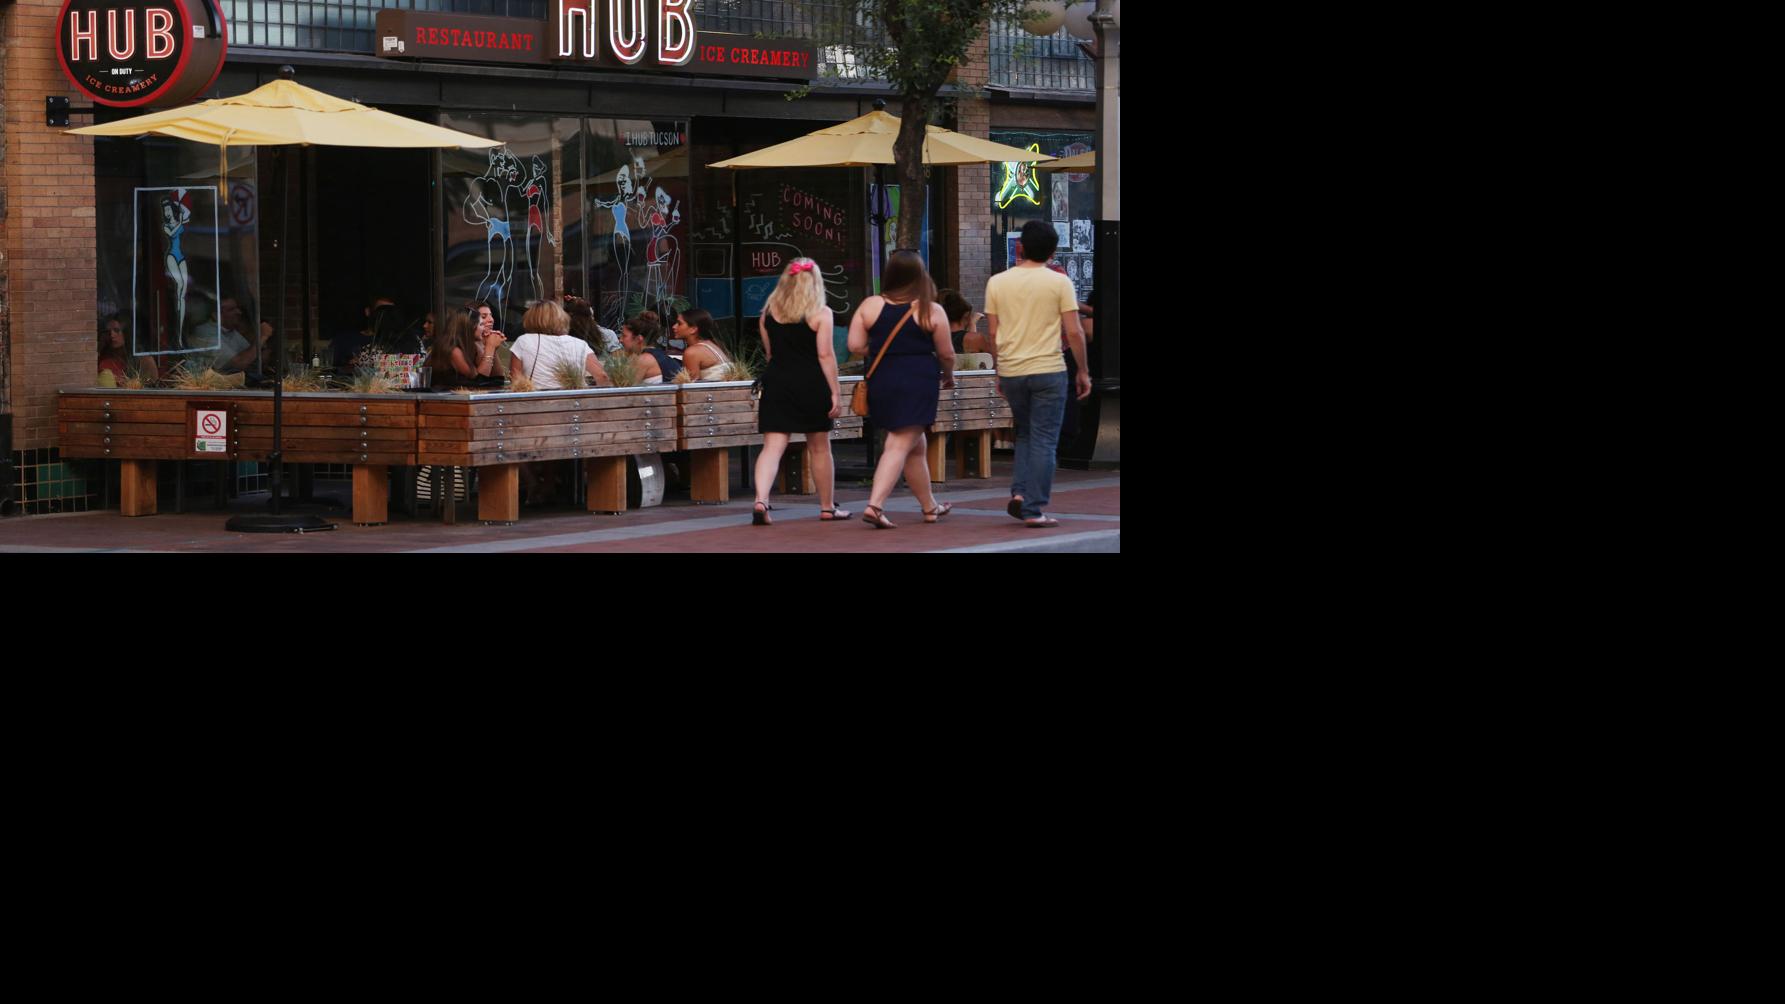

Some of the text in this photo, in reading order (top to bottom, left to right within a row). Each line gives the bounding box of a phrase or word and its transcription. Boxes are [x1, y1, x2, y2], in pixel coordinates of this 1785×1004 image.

[71, 8, 175, 61] HUB
[415, 27, 534, 51] RESTAURANT
[559, 0, 697, 65] HUB
[700, 45, 810, 68] ICE CREAMERY
[85, 73, 157, 94] ICE CREAMERY
[649, 131, 680, 146] TUCSON
[783, 188, 843, 226] COMING
[792, 212, 842, 246] SOON!
[752, 251, 781, 268] HUB
